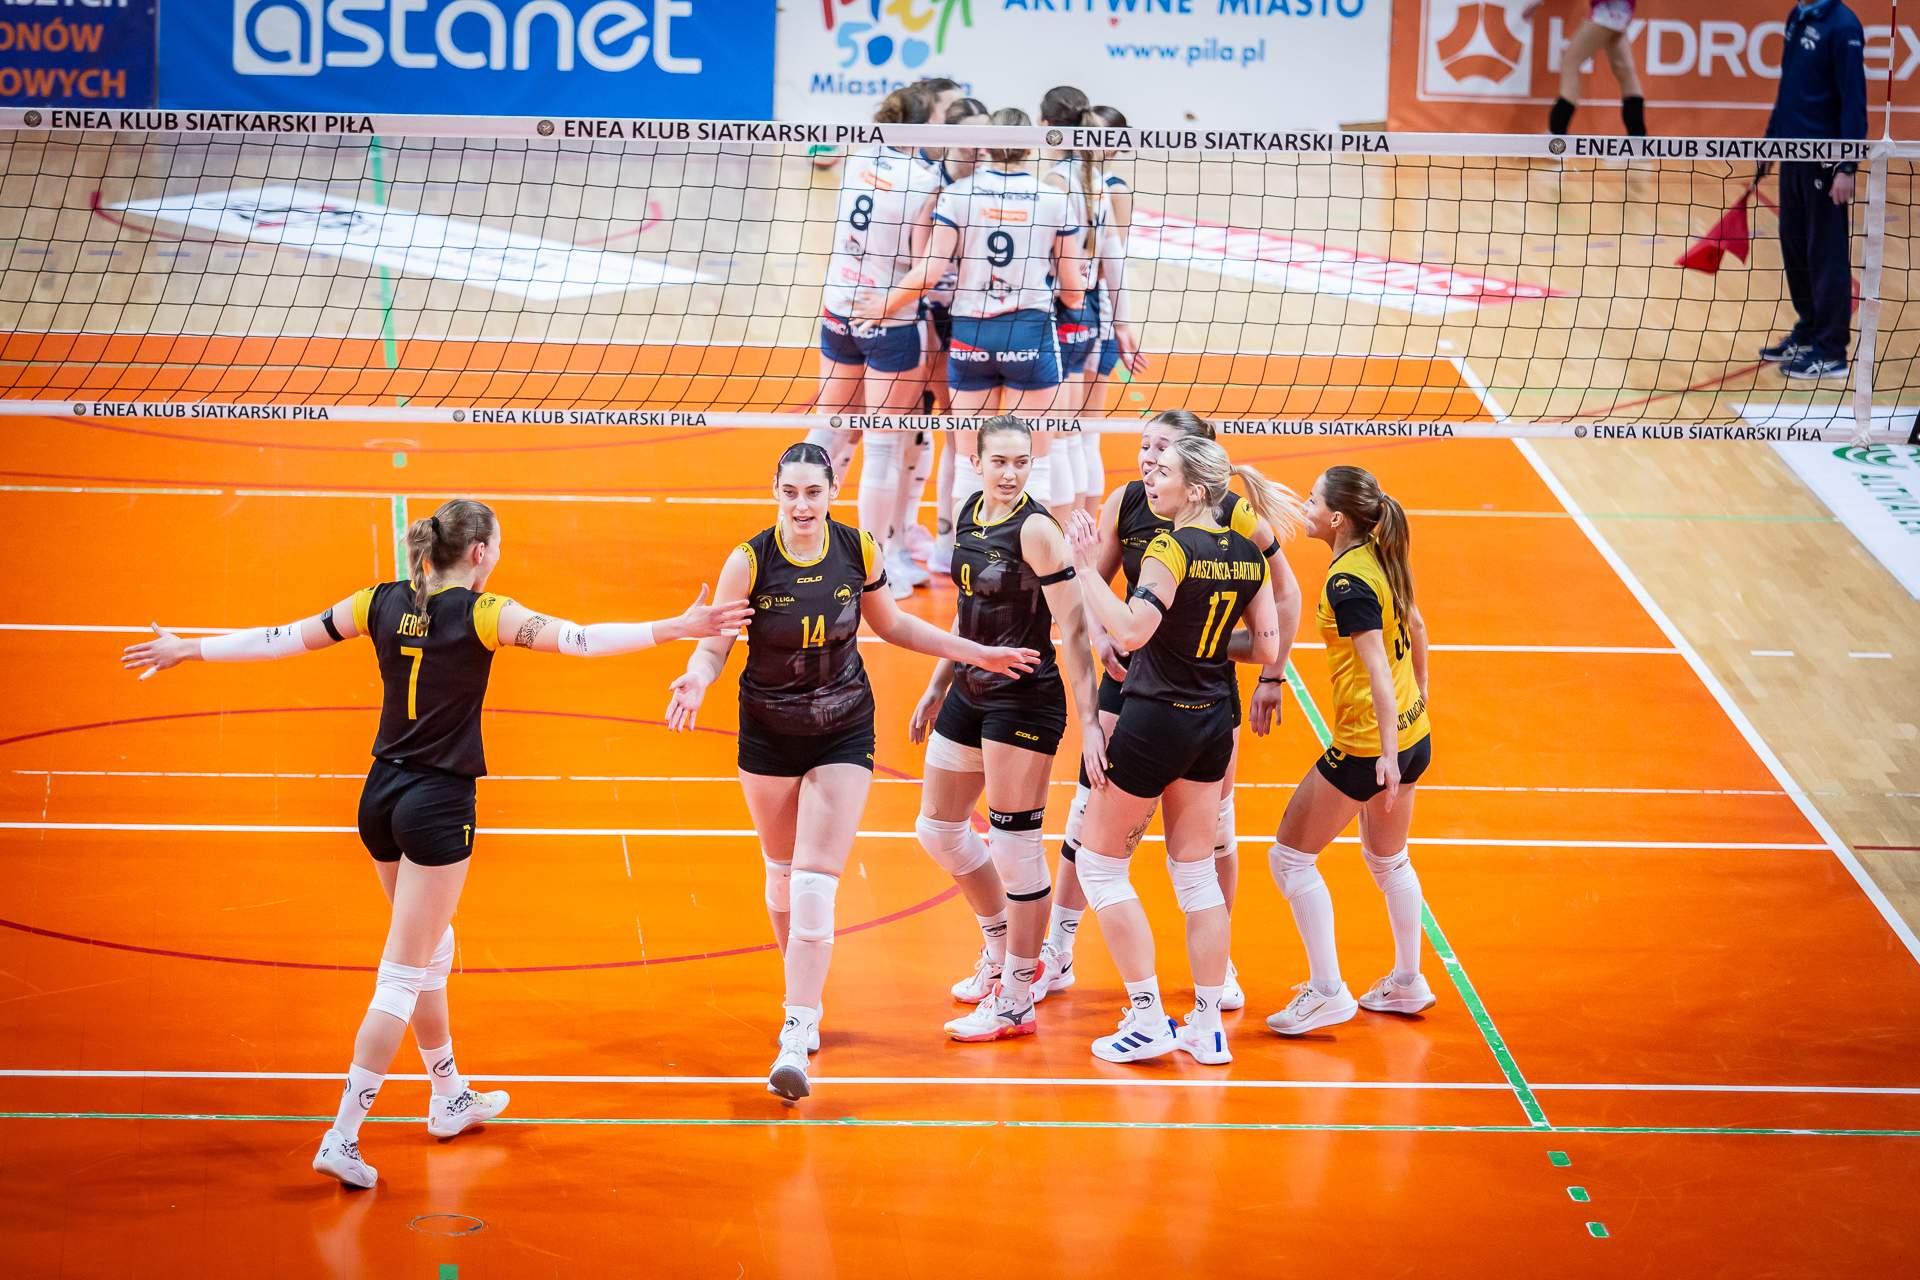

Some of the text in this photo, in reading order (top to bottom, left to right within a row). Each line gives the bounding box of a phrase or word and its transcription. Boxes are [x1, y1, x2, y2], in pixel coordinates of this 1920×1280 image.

[233, 0, 702, 76] astanet
[1107, 38, 1266, 67] www.pila.pl
[0, 67, 126, 98] OWYCH
[51, 110, 375, 134] ENEA KLUB SIATKARSKI PIŁA
[564, 119, 885, 144] ENEA KLUB SIATKARSKI PIŁA
[1073, 130, 1389, 152] ENEA KLUB SIATKARSKI PIŁA
[1576, 137, 1635, 156] ENEA
[1642, 138, 1699, 158] KLUB
[1706, 140, 1832, 159] SIATKARSKI
[850, 195, 873, 231] 8
[987, 230, 1014, 267] 9
[93, 403, 329, 420] ENEA KLUB SIATKARSKI PIŁA
[472, 410, 707, 426] ENEA KLUB SIATKARSKI PIŁA
[849, 416, 1081, 431] ENEA KLUB SIATKI PIŁA
[1223, 421, 1454, 437] ENEA KLUB SIATKARSKI PIŁA
[1594, 426, 1822, 441] ENEA KLUB SIATKARSKI PIŁA
[797, 575, 823, 584] COLO
[961, 563, 973, 597] 9
[801, 614, 826, 649] 14
[1196, 591, 1237, 659] 17
[401, 645, 423, 720] 7
[1015, 731, 1039, 741] COLO
